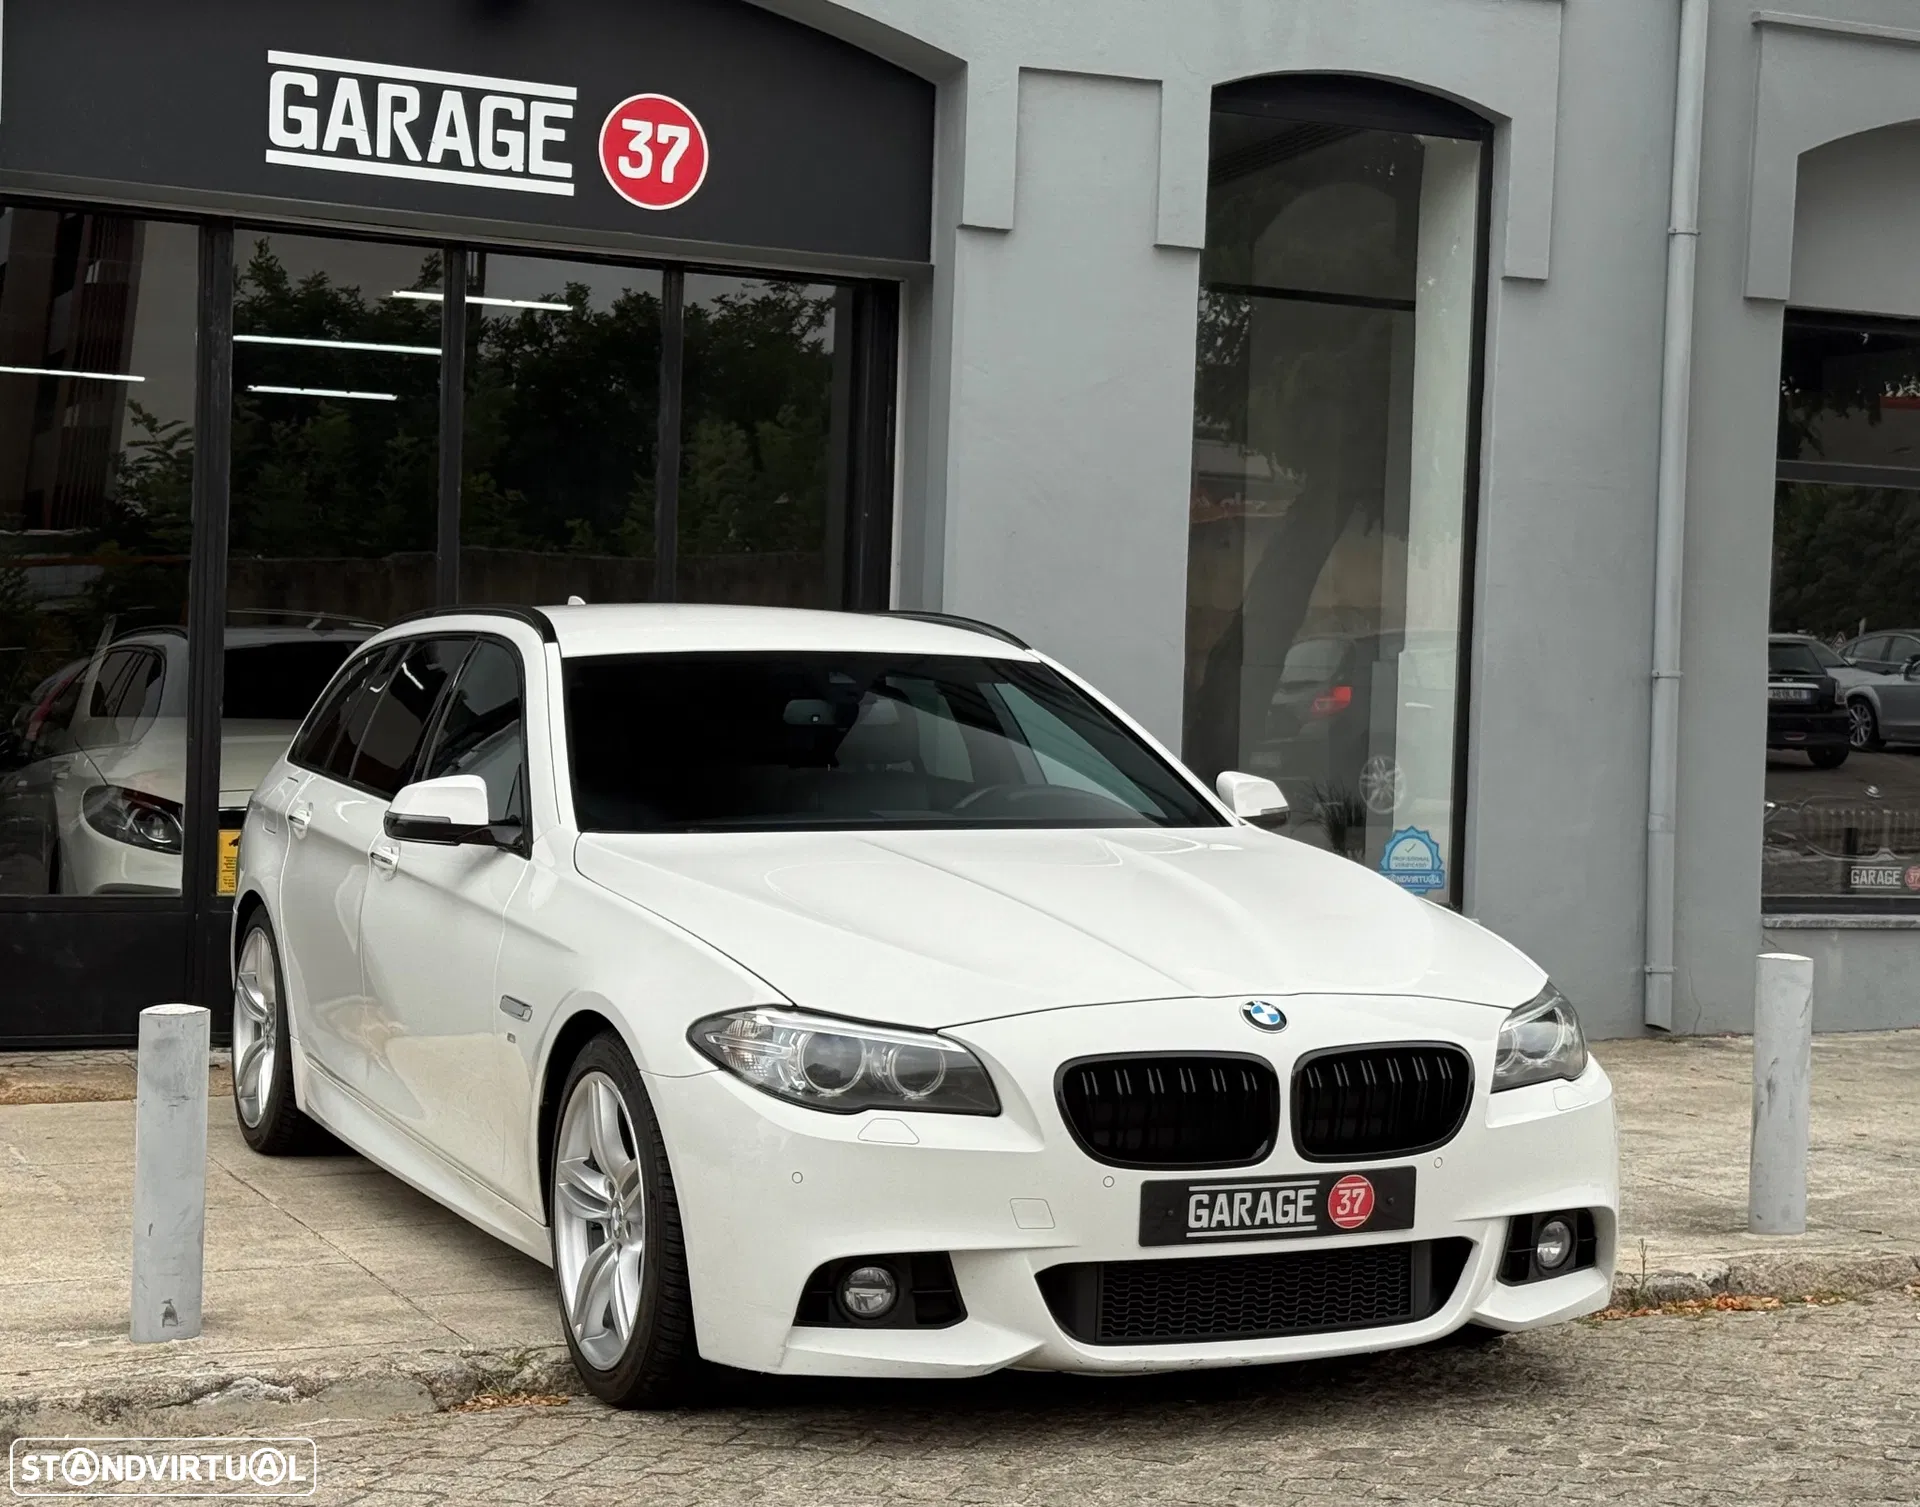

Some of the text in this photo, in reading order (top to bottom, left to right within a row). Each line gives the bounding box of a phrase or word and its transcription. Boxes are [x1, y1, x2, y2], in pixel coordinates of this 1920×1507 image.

[269, 70, 691, 183] GARAGE 37
[1850, 869, 1919, 885] GARAGE 37
[1187, 1188, 1366, 1229] GARAGE 37
